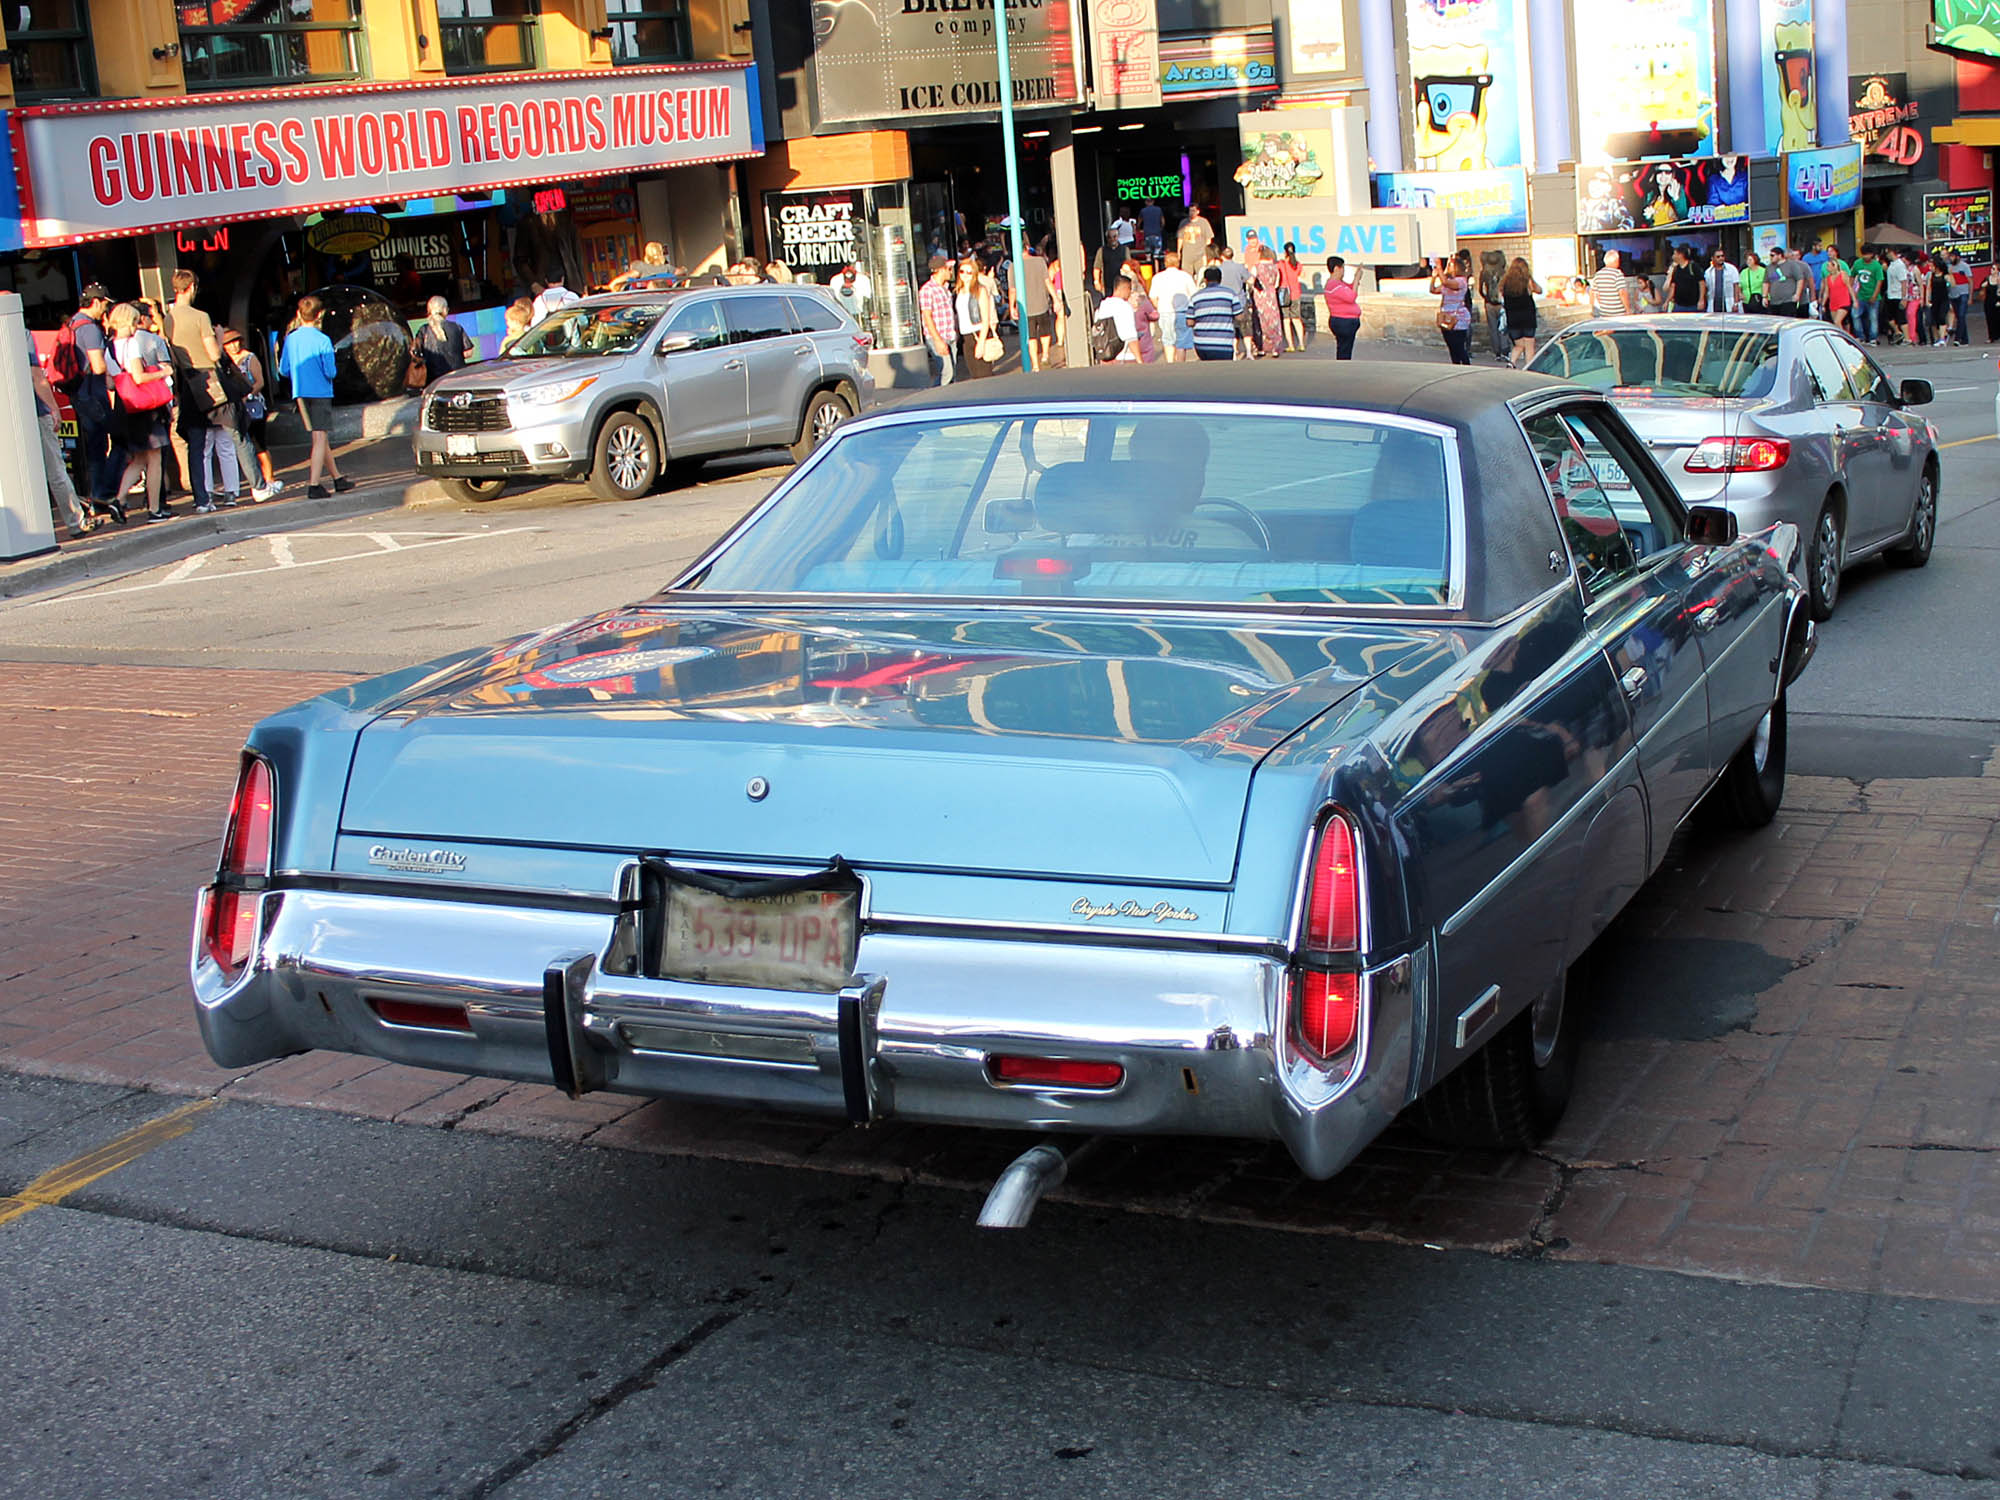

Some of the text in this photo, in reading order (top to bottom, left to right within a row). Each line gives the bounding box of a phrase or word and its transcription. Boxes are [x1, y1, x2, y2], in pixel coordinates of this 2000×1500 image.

[902, 0, 1042, 14] BREWNG
[934, 17, 1026, 36] compny
[1166, 61, 1275, 82] Arcade Ga
[900, 84, 944, 110] ICE
[1012, 77, 1056, 102] BEER
[88, 85, 732, 207] GUINNESS WORLD RECORDS MUSEUM
[1876, 125, 1923, 166] 4D
[1117, 175, 1180, 187] PHOTO STUDIO
[1118, 184, 1181, 200] DELUXE
[1795, 163, 1834, 202] 4D
[534, 188, 567, 213] OPEN
[780, 203, 853, 223] CRAFT
[176, 227, 230, 252] ON
[782, 220, 856, 244] BEER
[1239, 225, 1397, 254] FALLS AVE
[370, 234, 450, 260] GUINNESS
[783, 242, 857, 266] IS BREWING
[414, 257, 452, 270] ECORDS
[1607, 463, 1629, 481] 58
[369, 845, 466, 866] Garden City
[1070, 896, 1199, 923] Chrysler New Yorker
[694, 903, 842, 970] 539 DPA
